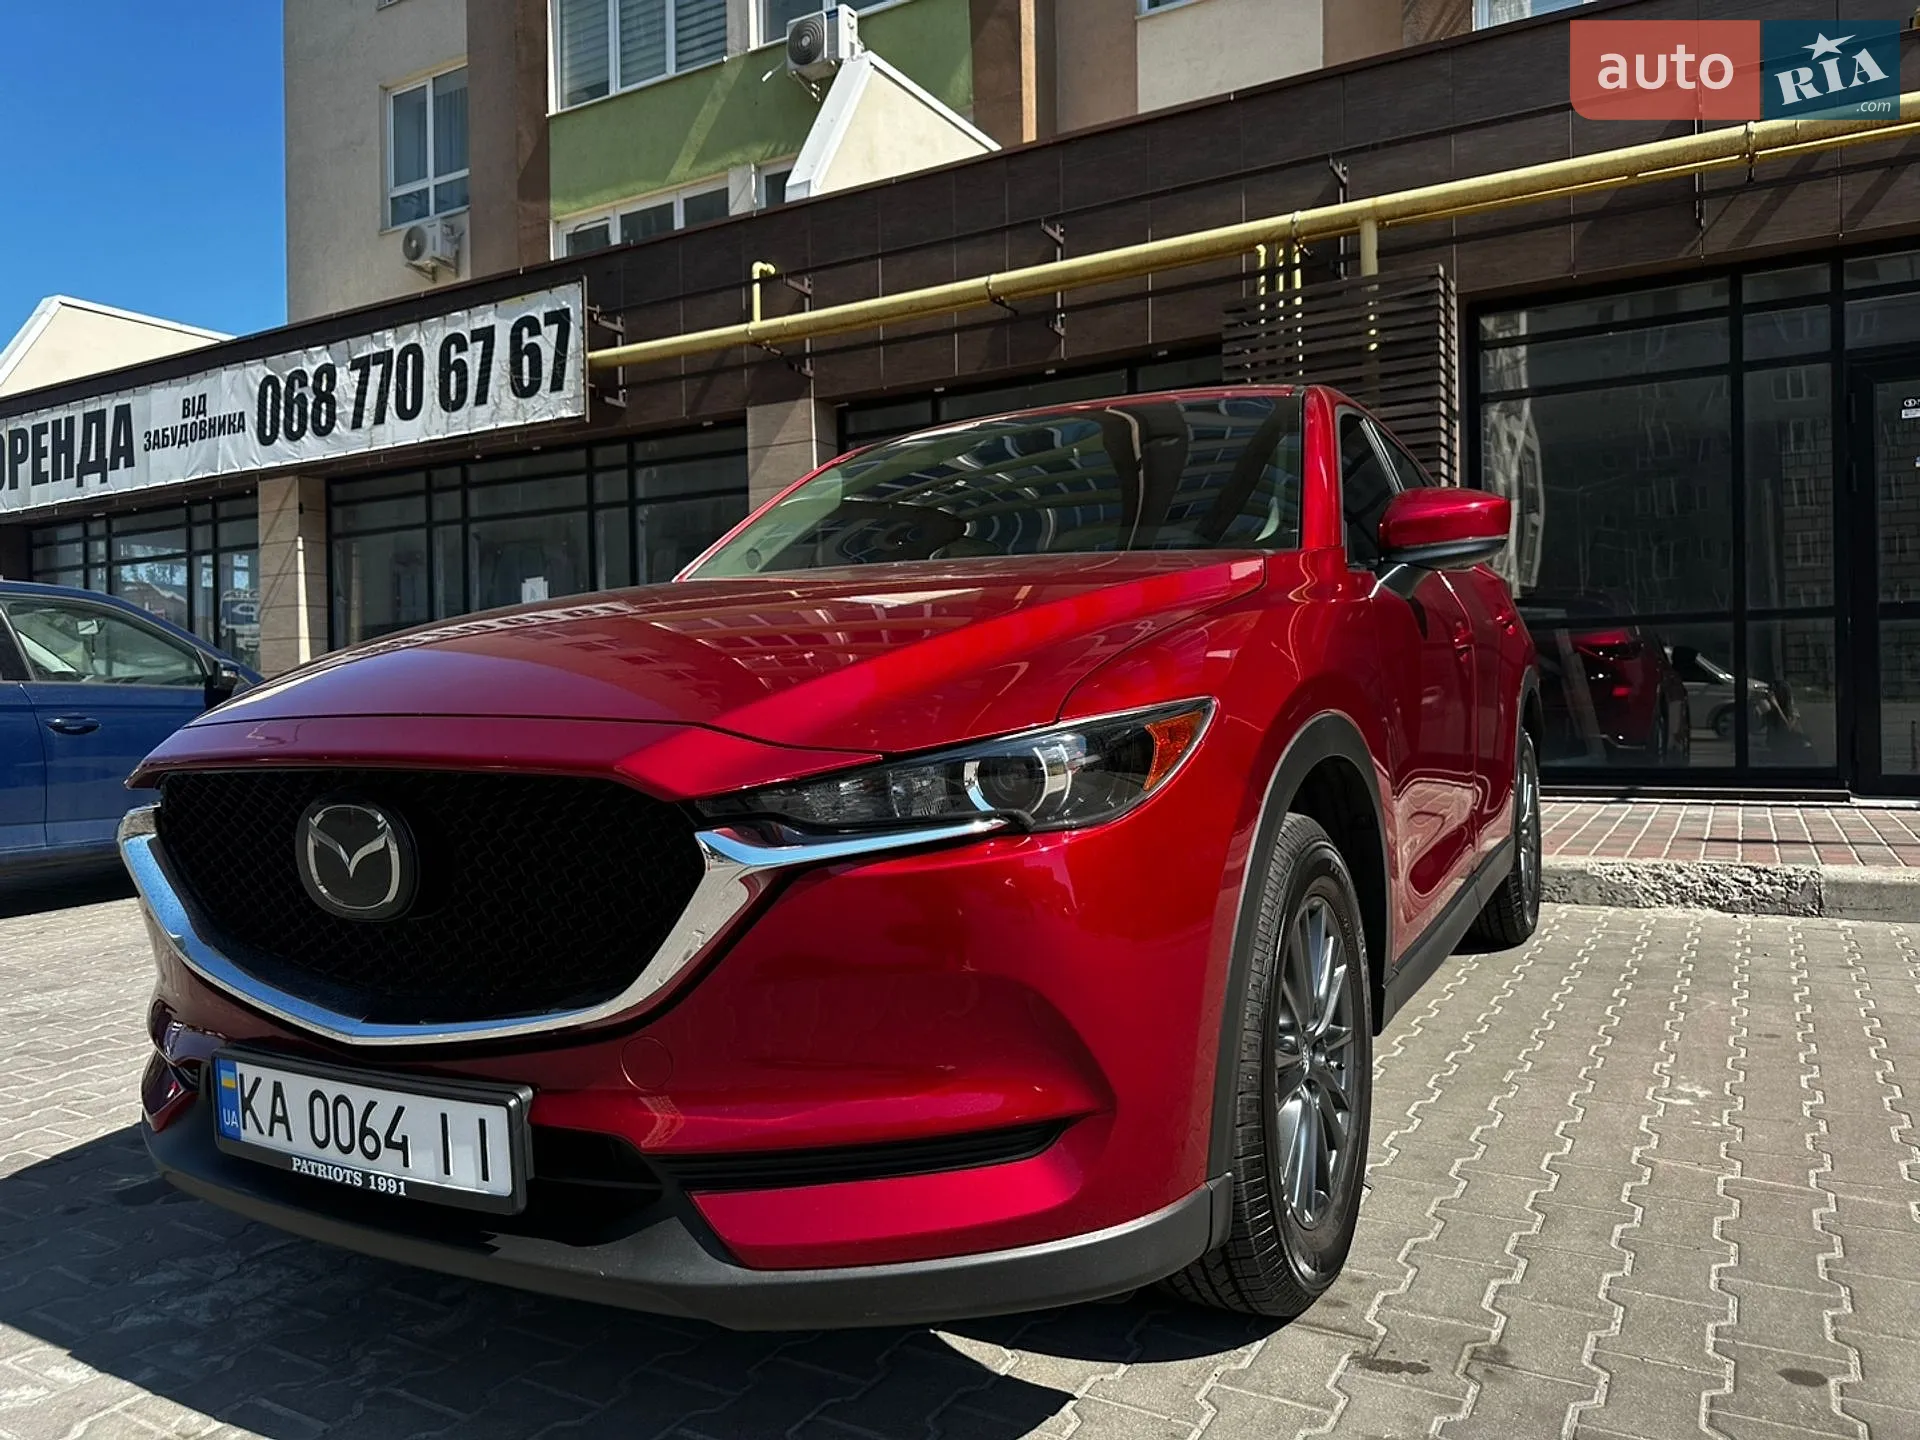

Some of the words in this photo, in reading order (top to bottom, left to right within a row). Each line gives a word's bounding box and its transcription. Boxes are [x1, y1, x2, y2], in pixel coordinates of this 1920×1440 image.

[257, 362, 337, 447] 068
[349, 343, 424, 430] 770
[437, 325, 496, 413] 67
[509, 308, 571, 399] 67
[181, 393, 208, 420] ВІД
[143, 411, 246, 453] ЗАБУДОВНИКА
[223, 1108, 239, 1128] UA
[238, 1072, 293, 1142] KA
[308, 1089, 410, 1168] 0064
[440, 1112, 489, 1182] II
[291, 1156, 363, 1187] PATRIOTS
[368, 1173, 407, 1197] 1991
